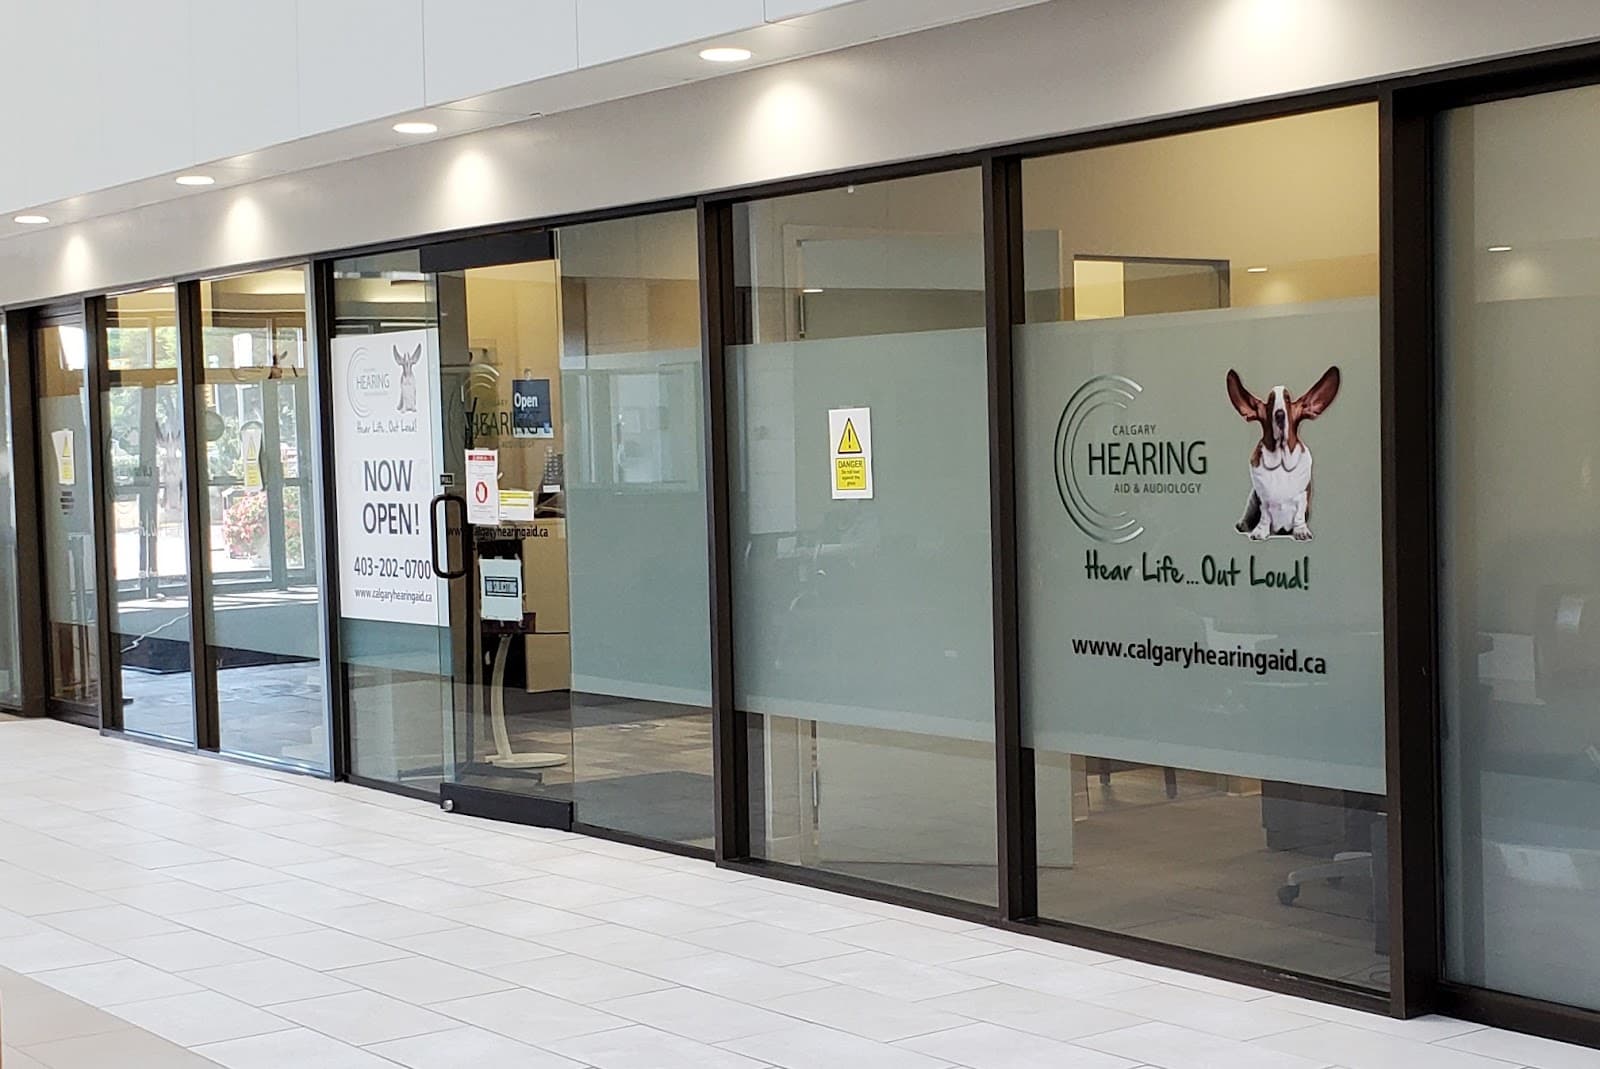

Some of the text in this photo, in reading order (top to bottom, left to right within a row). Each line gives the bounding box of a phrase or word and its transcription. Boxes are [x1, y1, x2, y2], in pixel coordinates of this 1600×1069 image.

[514, 392, 538, 411] Open
[1112, 424, 1156, 436] CALGARY
[838, 460, 862, 468] DANGER
[1088, 441, 1208, 476] HEARING
[364, 460, 412, 492] NOW
[1114, 483, 1201, 494] AID & AUDIOLOGY
[363, 502, 419, 535] OPEN!
[354, 556, 431, 580] 403-202-0700
[1085, 550, 1132, 581] Hear
[1250, 555, 1310, 591] Loud!
[354, 587, 432, 604] www.calgaryhearingaid.ca
[1072, 638, 1327, 675] www.calgaryhearingaid.ca
